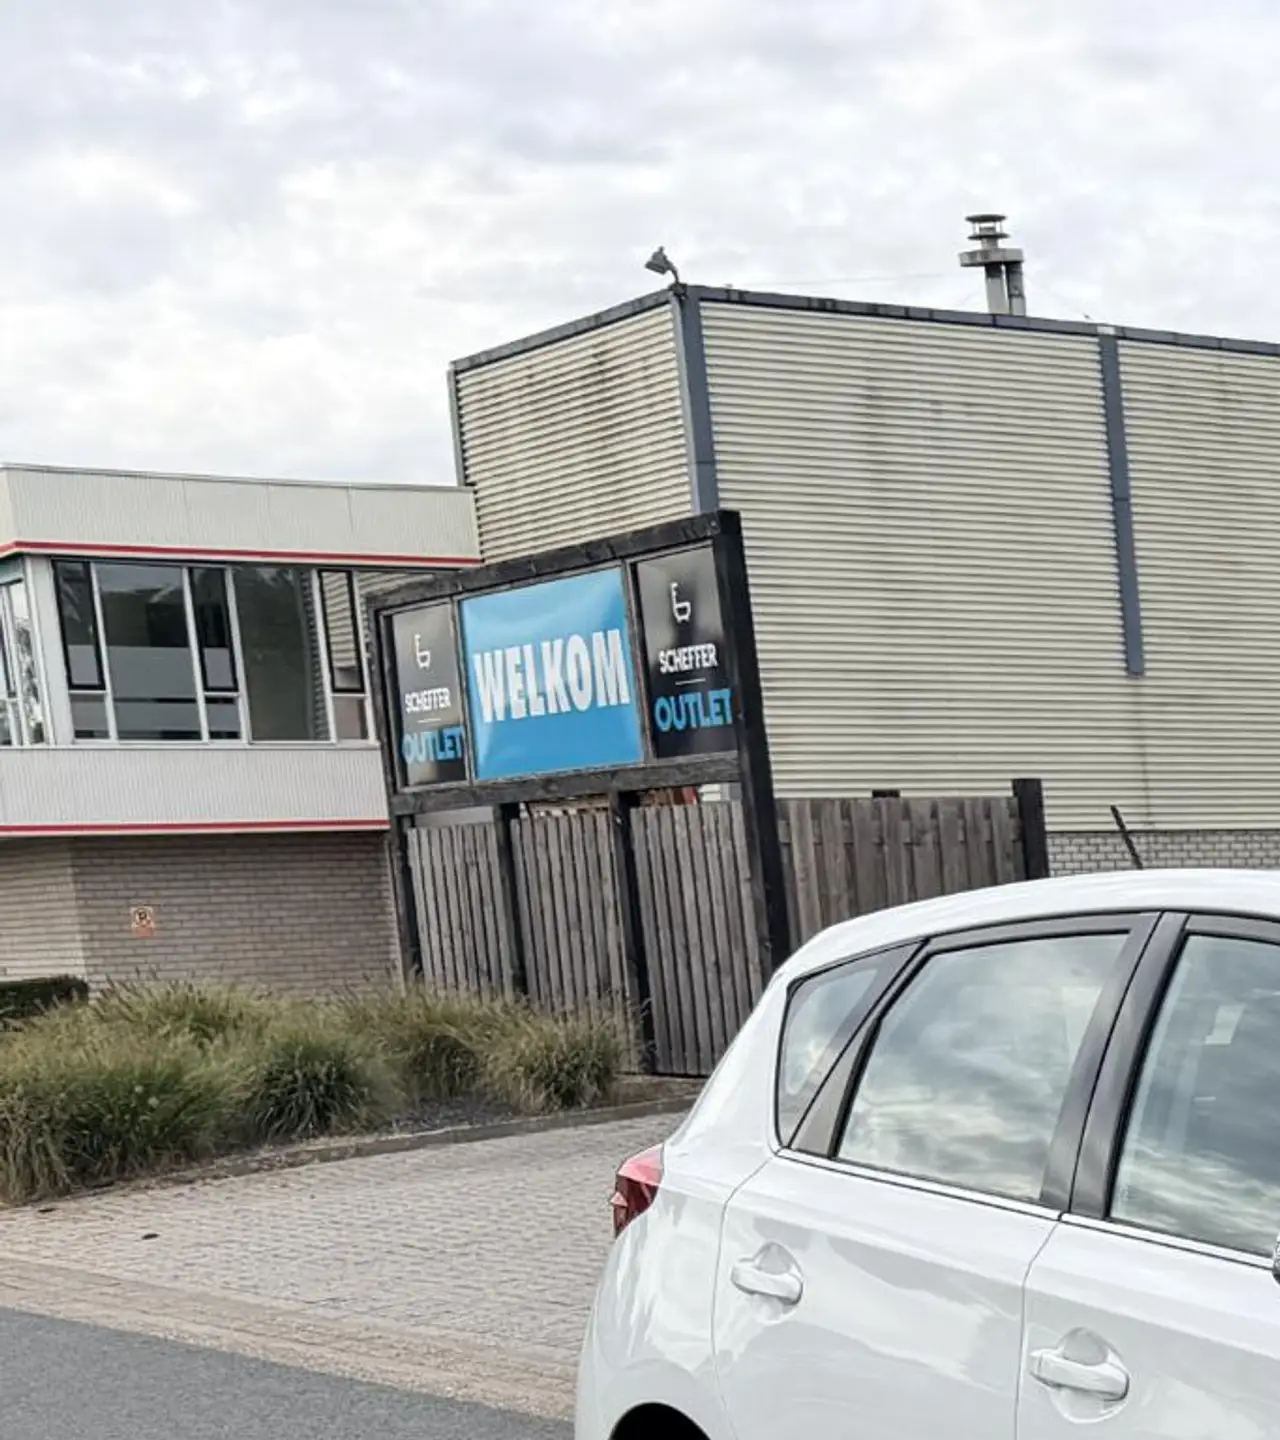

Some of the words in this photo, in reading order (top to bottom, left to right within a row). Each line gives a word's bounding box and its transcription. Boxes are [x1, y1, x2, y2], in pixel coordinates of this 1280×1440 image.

[473, 628, 631, 723] WELKOM
[659, 643, 718, 674] SCHEFFER
[404, 687, 451, 713] SCHEFFER
[655, 688, 732, 732] OUTLET
[402, 727, 463, 763] OUTLET
